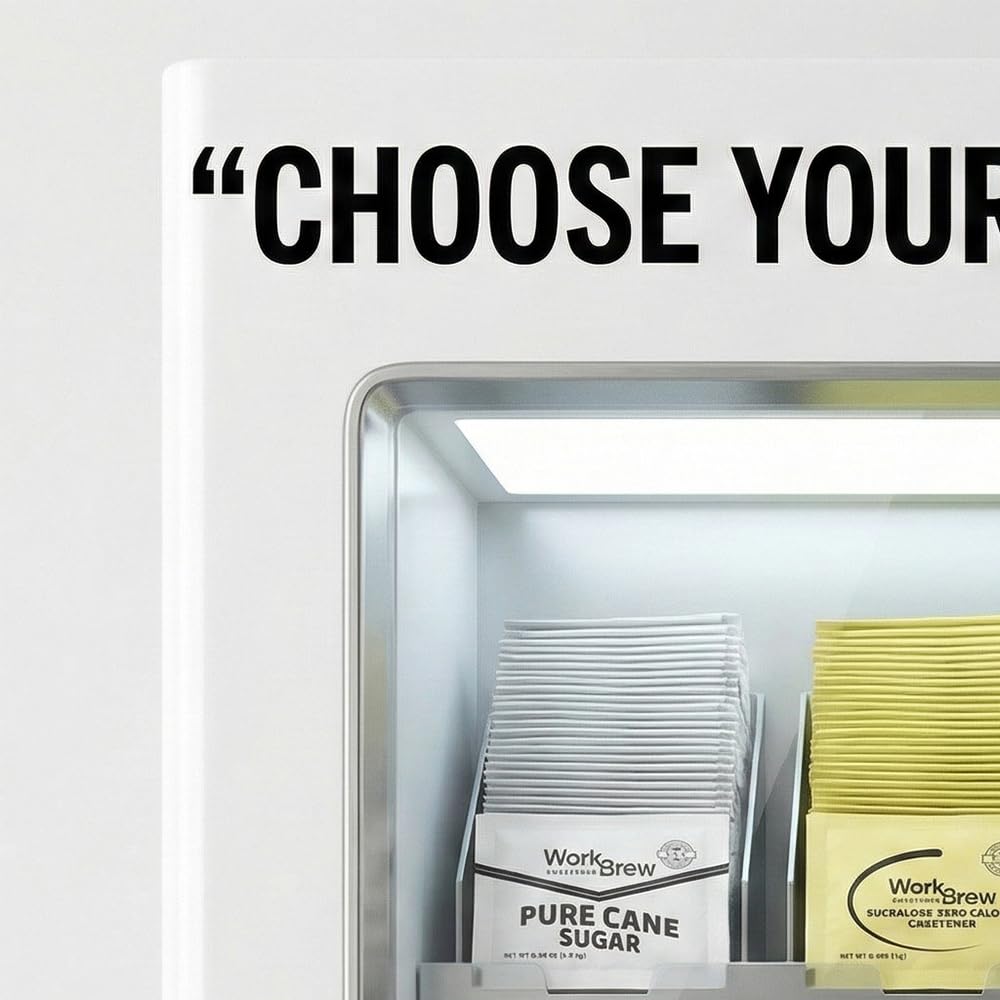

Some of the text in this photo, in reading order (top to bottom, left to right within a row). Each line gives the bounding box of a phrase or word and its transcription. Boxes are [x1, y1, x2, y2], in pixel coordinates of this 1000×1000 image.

[543, 848, 657, 877] WorkBrew
[888, 878, 997, 905] WorkBrew
[520, 903, 680, 939] PURE CANE
[866, 908, 933, 918] SUCRALOSE
[559, 927, 641, 954] SUGAR
